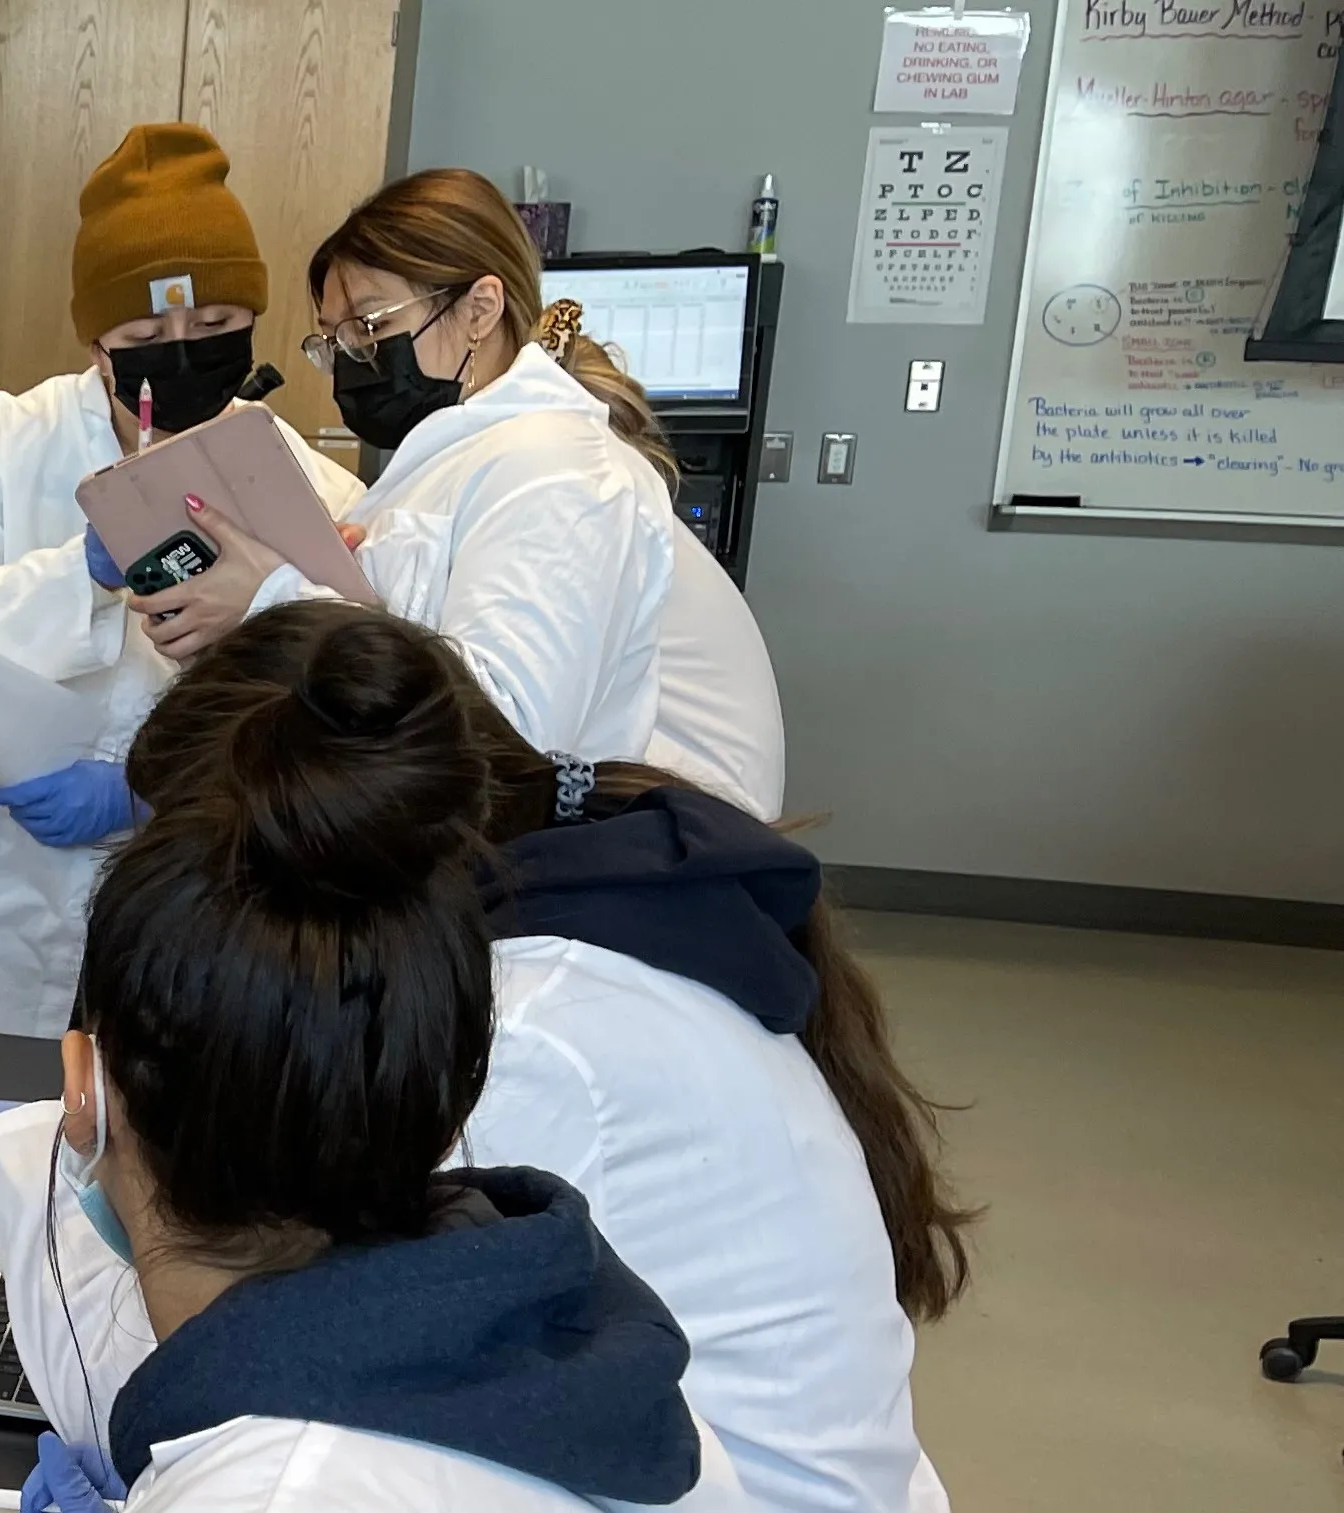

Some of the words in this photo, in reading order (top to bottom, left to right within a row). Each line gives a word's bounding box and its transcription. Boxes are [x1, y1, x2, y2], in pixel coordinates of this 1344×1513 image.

[1085, 0, 1147, 35] Kirby
[1154, 0, 1221, 25] Bauer
[1222, 0, 1308, 29] Method
[913, 41, 934, 53] NO
[977, 57, 998, 68] OR
[896, 72, 963, 84] CHEWING
[966, 72, 1000, 84] GUM
[923, 88, 938, 99] IN
[941, 88, 969, 99] LAB
[1219, 90, 1274, 112] agar
[899, 150, 924, 173] T
[944, 150, 971, 173] Z
[878, 183, 895, 199] P
[908, 183, 924, 199] T
[937, 183, 953, 199] O
[966, 183, 983, 199] C
[1122, 178, 1142, 202] of
[1154, 179, 1261, 200] Inhibition
[874, 208, 887, 221] Z
[897, 208, 910, 221] L
[921, 208, 934, 221] P
[944, 208, 958, 221] E
[967, 208, 981, 221] D
[1028, 397, 1099, 418] Bacteria
[1105, 403, 1133, 417] will
[1139, 405, 1178, 423] grow
[1181, 403, 1204, 418] all
[1211, 407, 1251, 420] over
[1036, 422, 1058, 437] the
[1065, 423, 1111, 443] plate
[1121, 423, 1178, 442] unless
[1186, 427, 1200, 443] it
[1208, 428, 1222, 444] is
[1032, 445, 1053, 467] by
[1060, 448, 1082, 464] the
[1090, 449, 1179, 467] antibiotics
[1298, 457, 1320, 472] No
